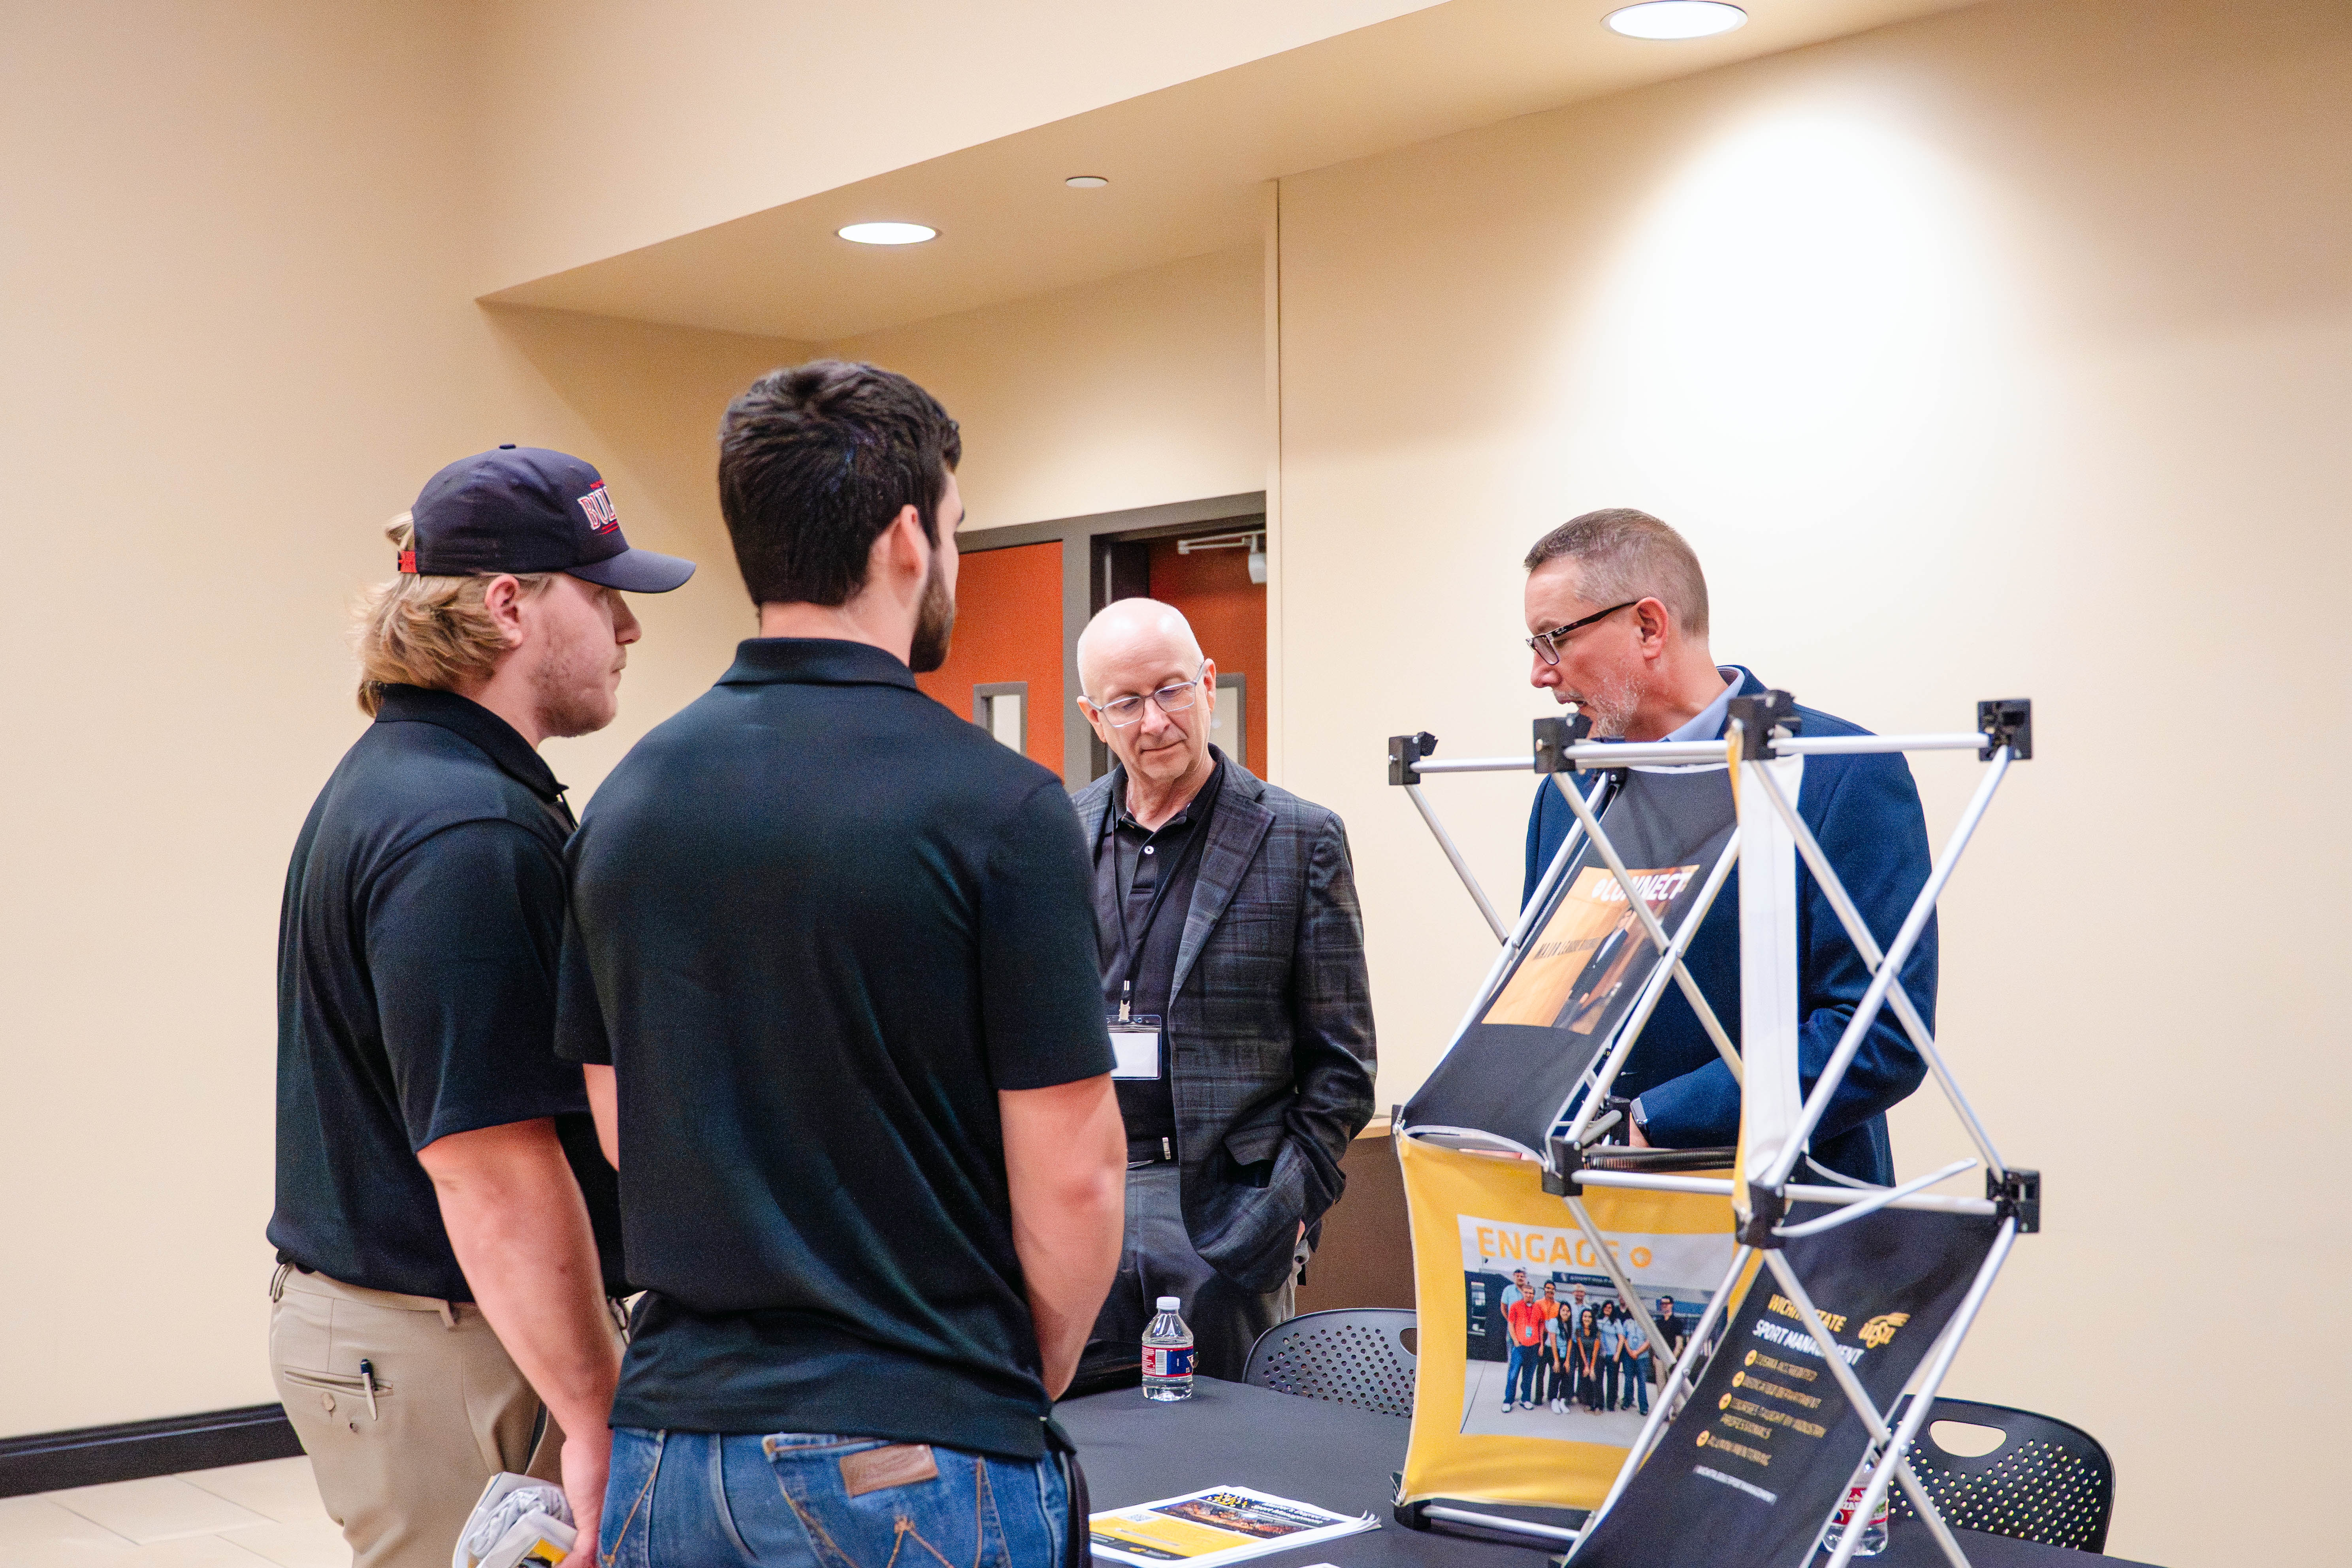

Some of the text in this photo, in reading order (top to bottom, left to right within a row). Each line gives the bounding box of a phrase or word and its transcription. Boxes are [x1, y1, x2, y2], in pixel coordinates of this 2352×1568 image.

[577, 486, 617, 530] BUL
[1768, 1294, 1804, 1321] WICHI
[1752, 1319, 1789, 1344] SPORT
[1783, 1332, 1865, 1366] MANAENT
